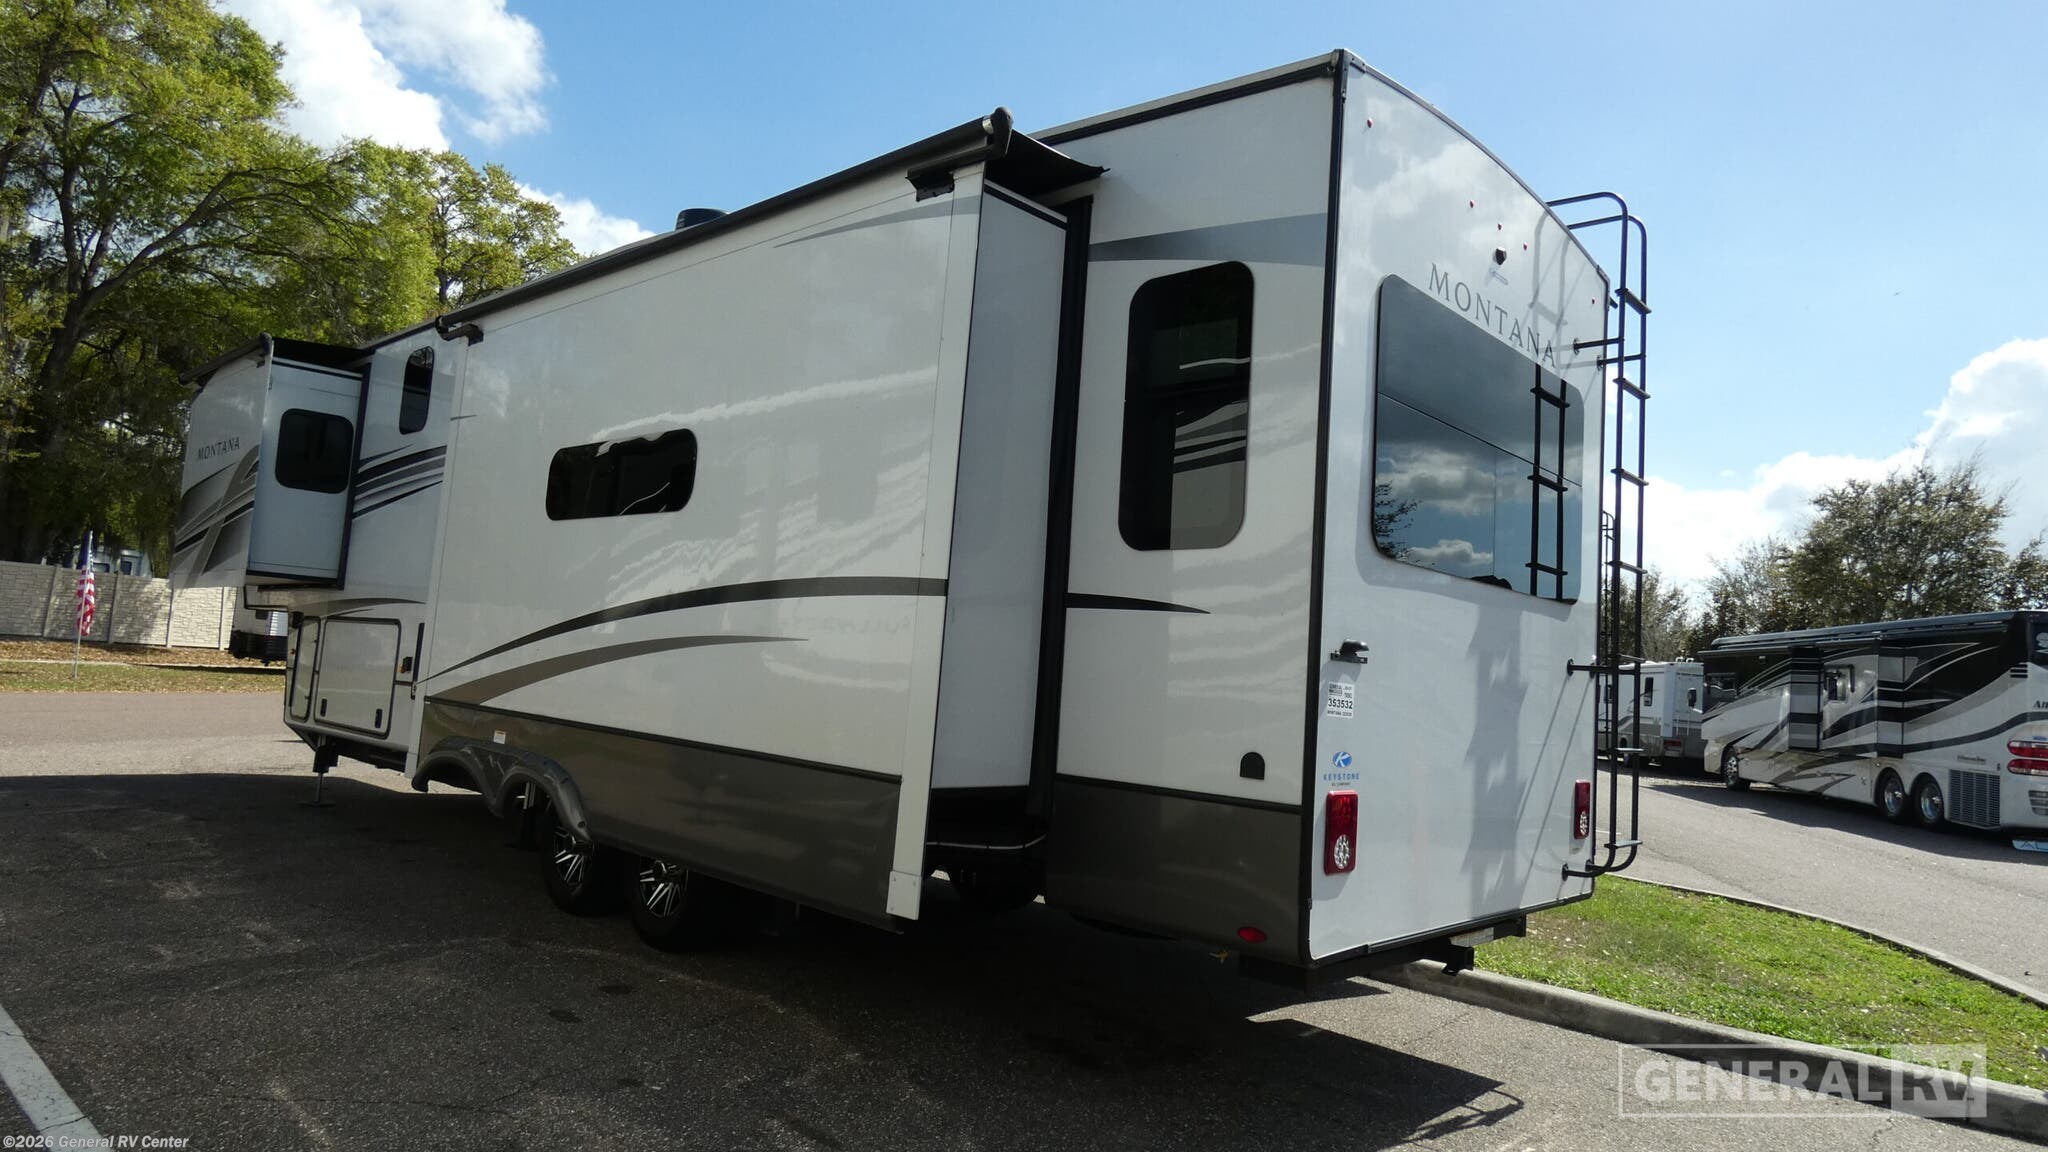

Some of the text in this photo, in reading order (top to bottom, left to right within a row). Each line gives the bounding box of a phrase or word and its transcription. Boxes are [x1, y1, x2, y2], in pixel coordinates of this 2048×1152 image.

[1429, 262, 1556, 368] MONTANA
[198, 436, 240, 461] MONTANA
[1328, 698, 1353, 710] 353532
[1323, 773, 1360, 781] KEYSTONE
